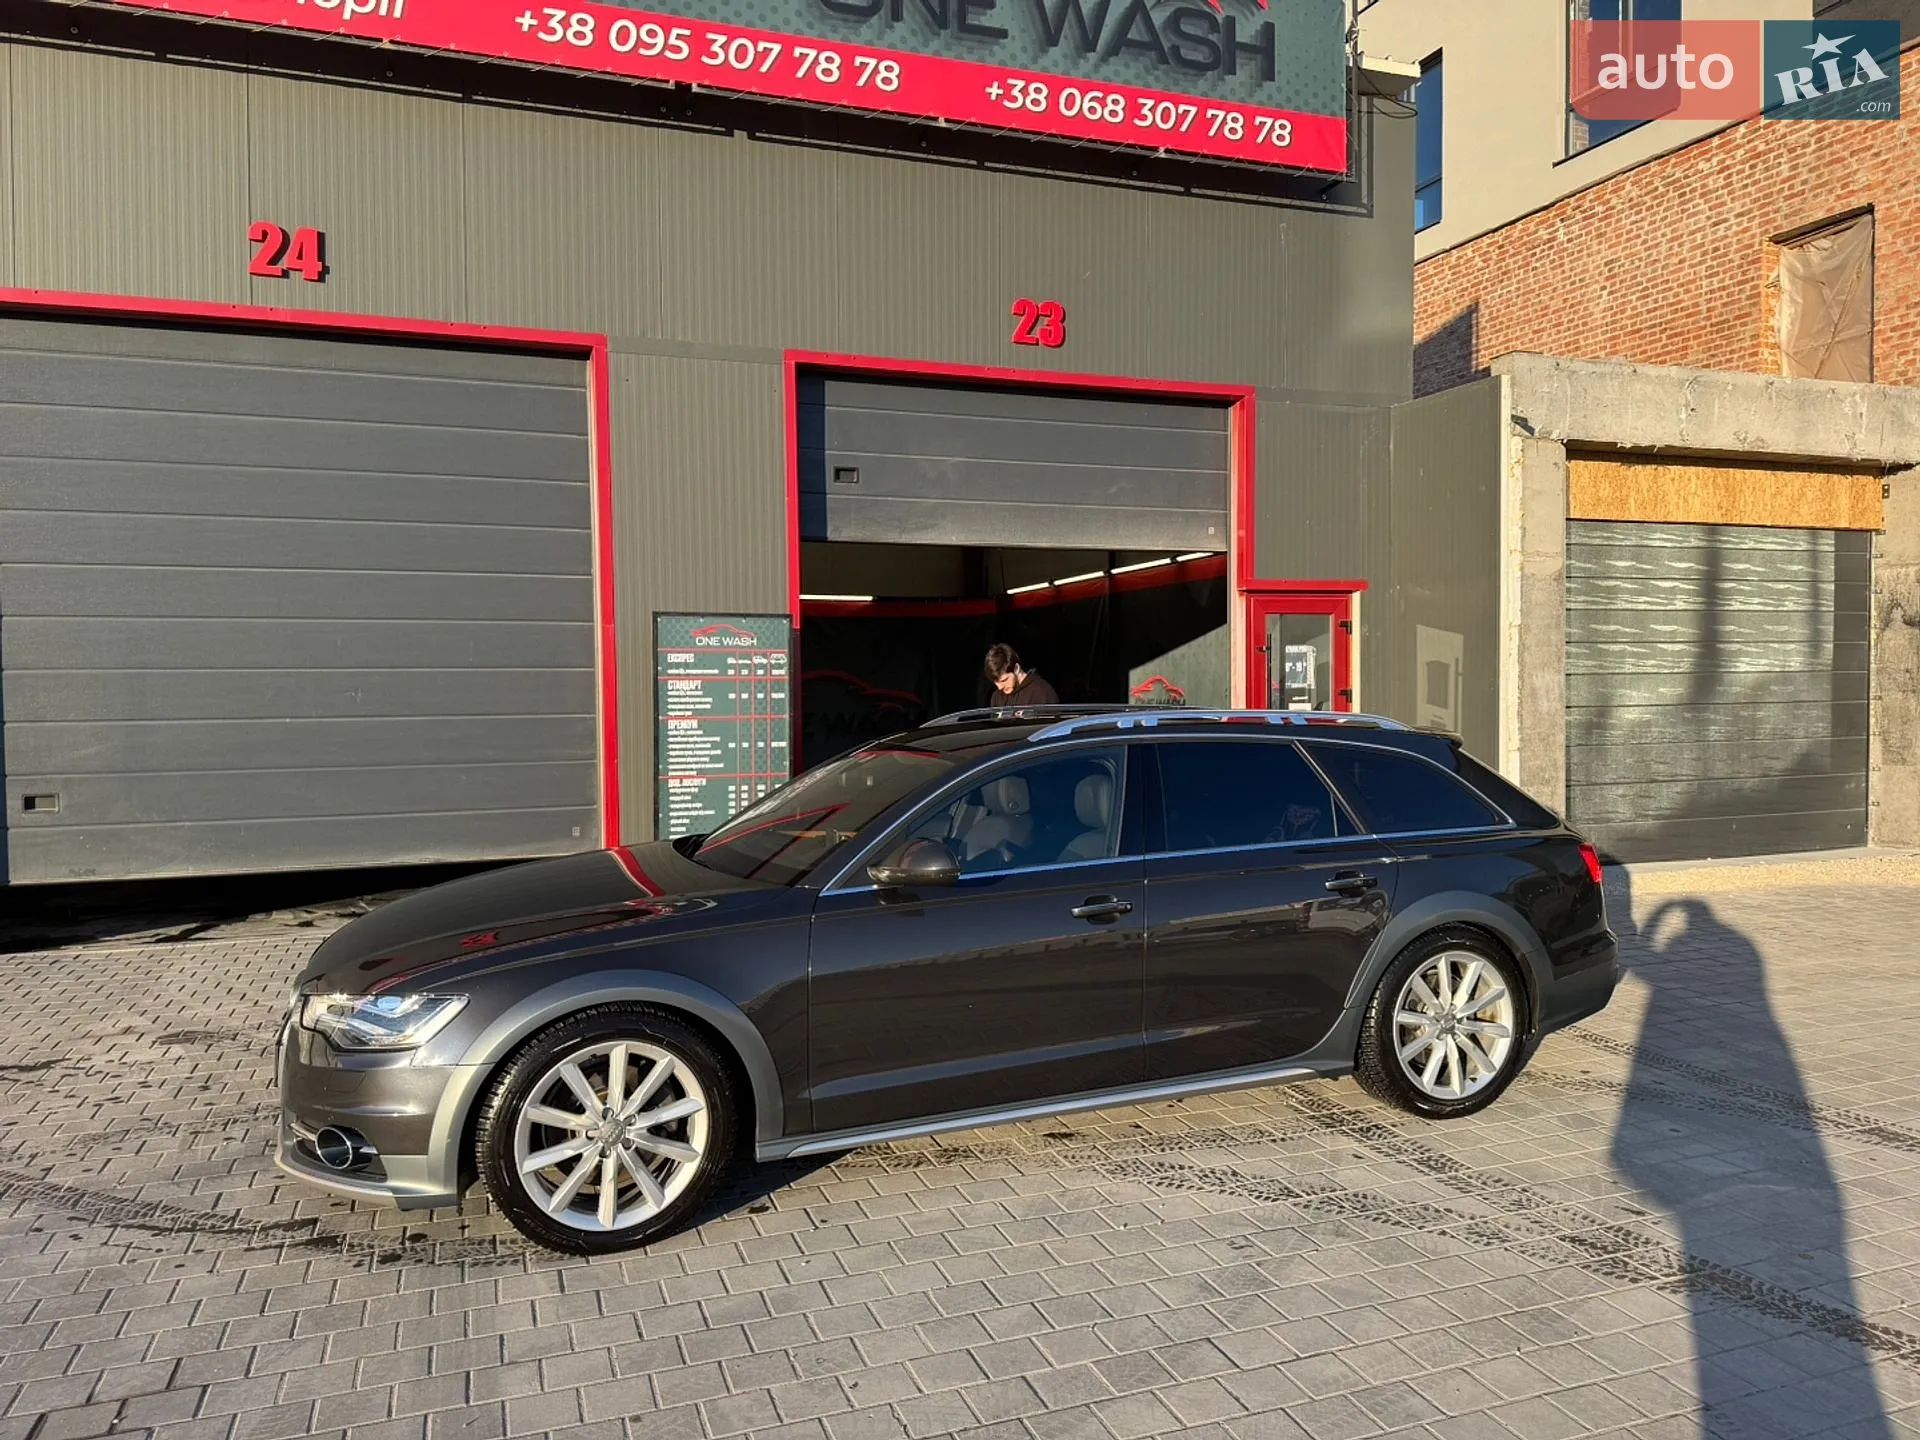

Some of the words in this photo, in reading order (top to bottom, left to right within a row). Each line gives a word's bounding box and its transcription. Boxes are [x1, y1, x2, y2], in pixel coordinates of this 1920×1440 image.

[514, 7, 596, 47] +38
[608, 19, 691, 61] 095
[701, 32, 782, 73] 307
[793, 46, 842, 83] 78
[853, 55, 901, 93] 78
[1038, 0, 1277, 82] WASH
[985, 78, 1049, 112] +38
[1058, 87, 1126, 124] 068
[1132, 97, 1197, 133] 307
[1205, 107, 1244, 141] 78
[1254, 114, 1292, 147] 78
[248, 220, 325, 282] 24
[1011, 298, 1066, 348] 23
[695, 636, 721, 646] ONE
[721, 636, 758, 646] WASH
